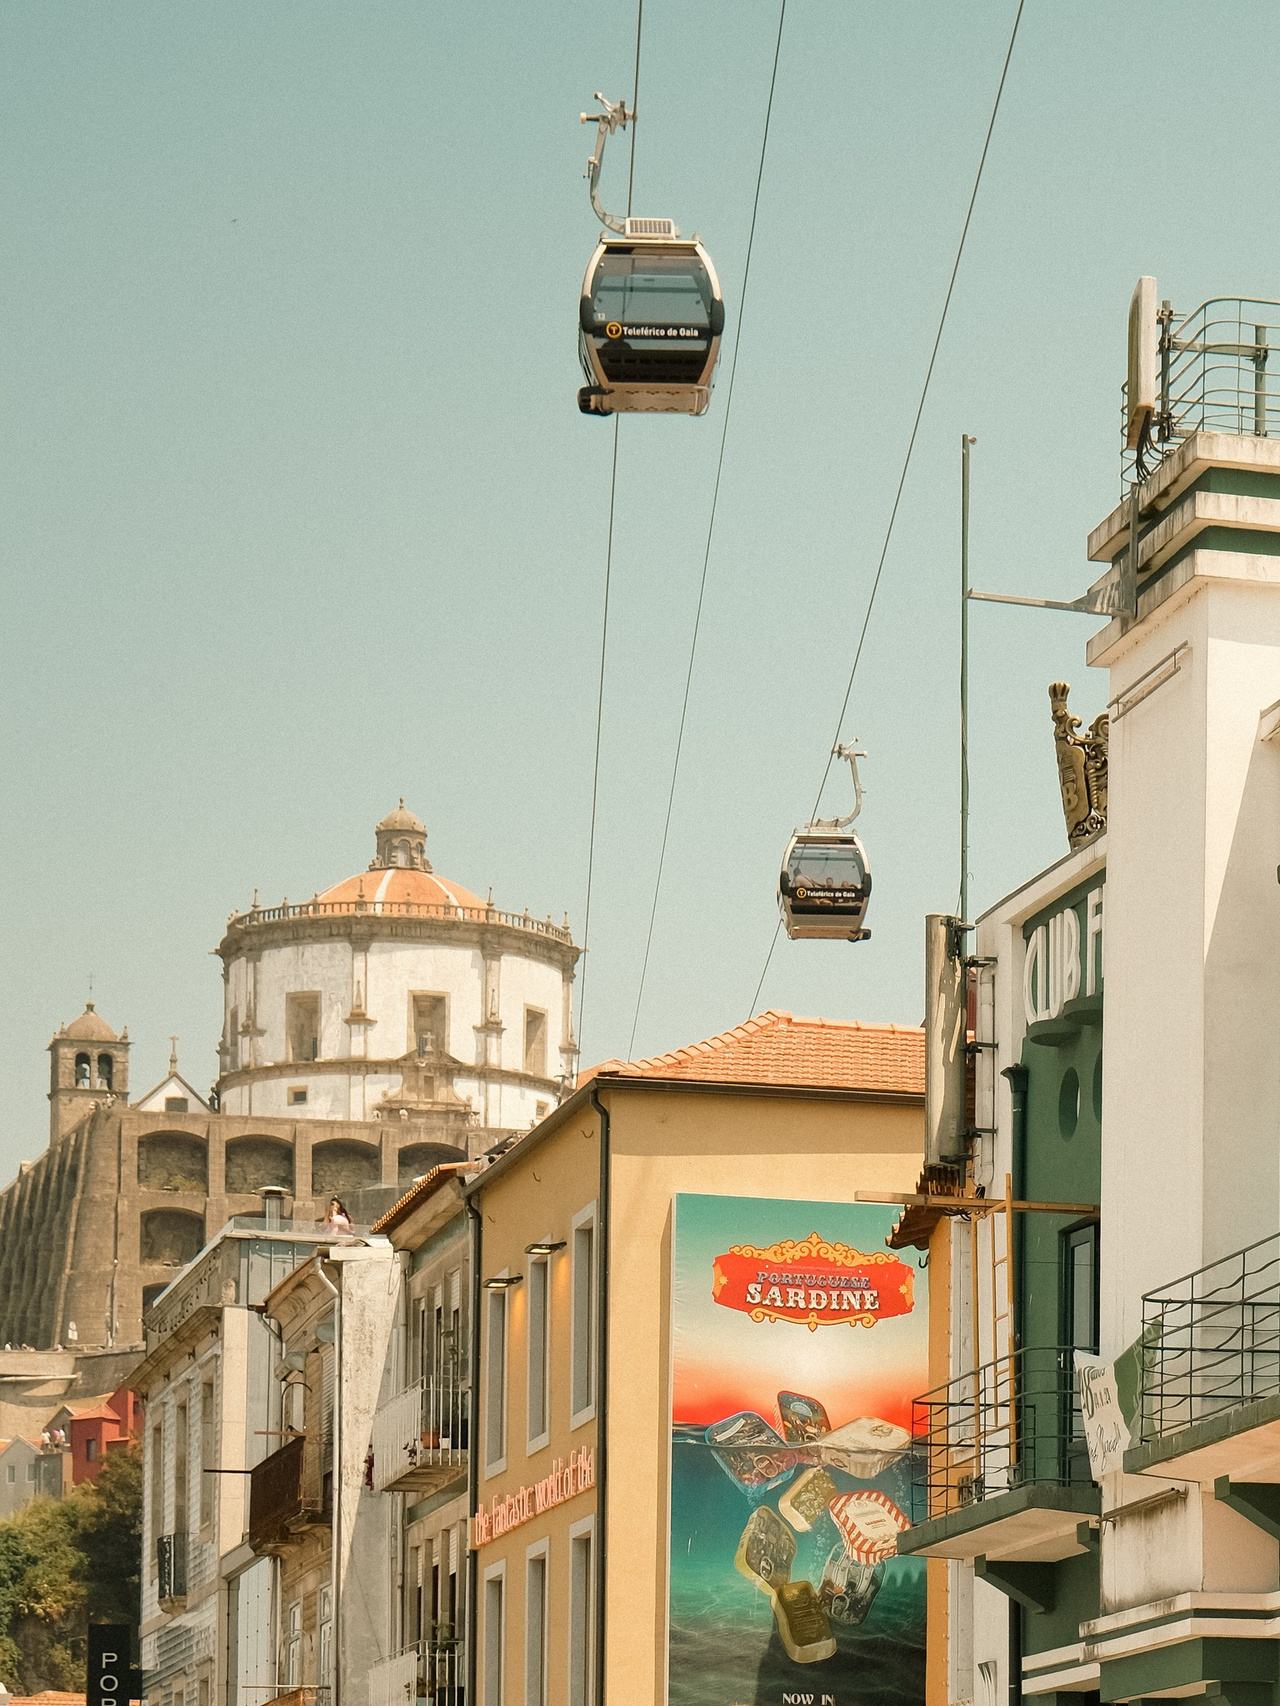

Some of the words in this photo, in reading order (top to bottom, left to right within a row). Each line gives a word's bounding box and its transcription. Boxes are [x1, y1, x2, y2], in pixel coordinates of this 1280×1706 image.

[622, 326, 666, 336] Teleférico
[667, 327, 678, 336] de
[1024, 906, 1081, 1026] CLUB
[756, 1271, 871, 1290] PORTUGUESE
[746, 1283, 880, 1310] SARDINE
[492, 1486, 535, 1540] fantastic
[534, 1456, 566, 1515] world
[563, 1449, 578, 1498] of
[782, 1693, 814, 1705] NOW
[821, 1694, 835, 1706] IN
